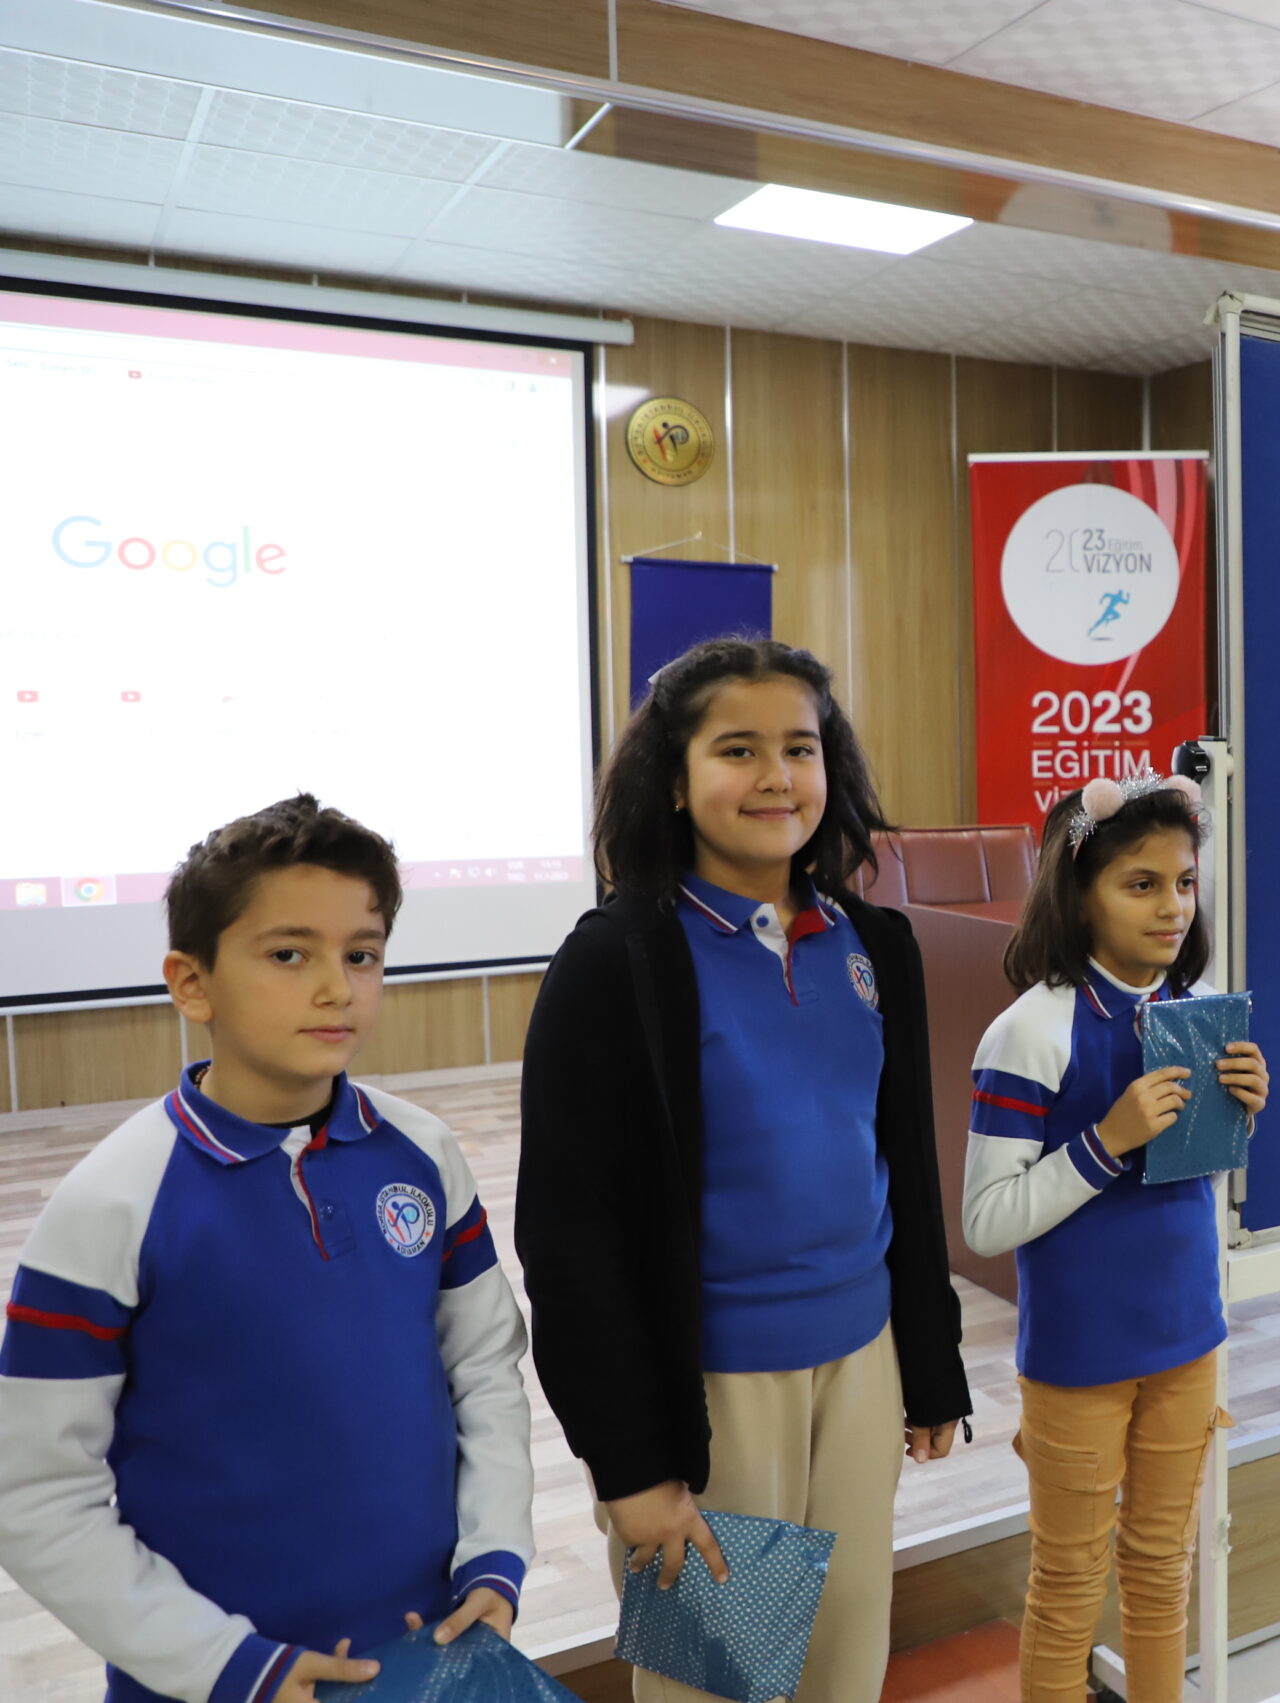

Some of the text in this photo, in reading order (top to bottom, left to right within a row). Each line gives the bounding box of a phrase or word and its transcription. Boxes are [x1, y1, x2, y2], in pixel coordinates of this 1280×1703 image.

[52, 515, 288, 588] Google
[1031, 690, 1153, 734] 2023
[1031, 740, 1152, 779] EĞİTİM
